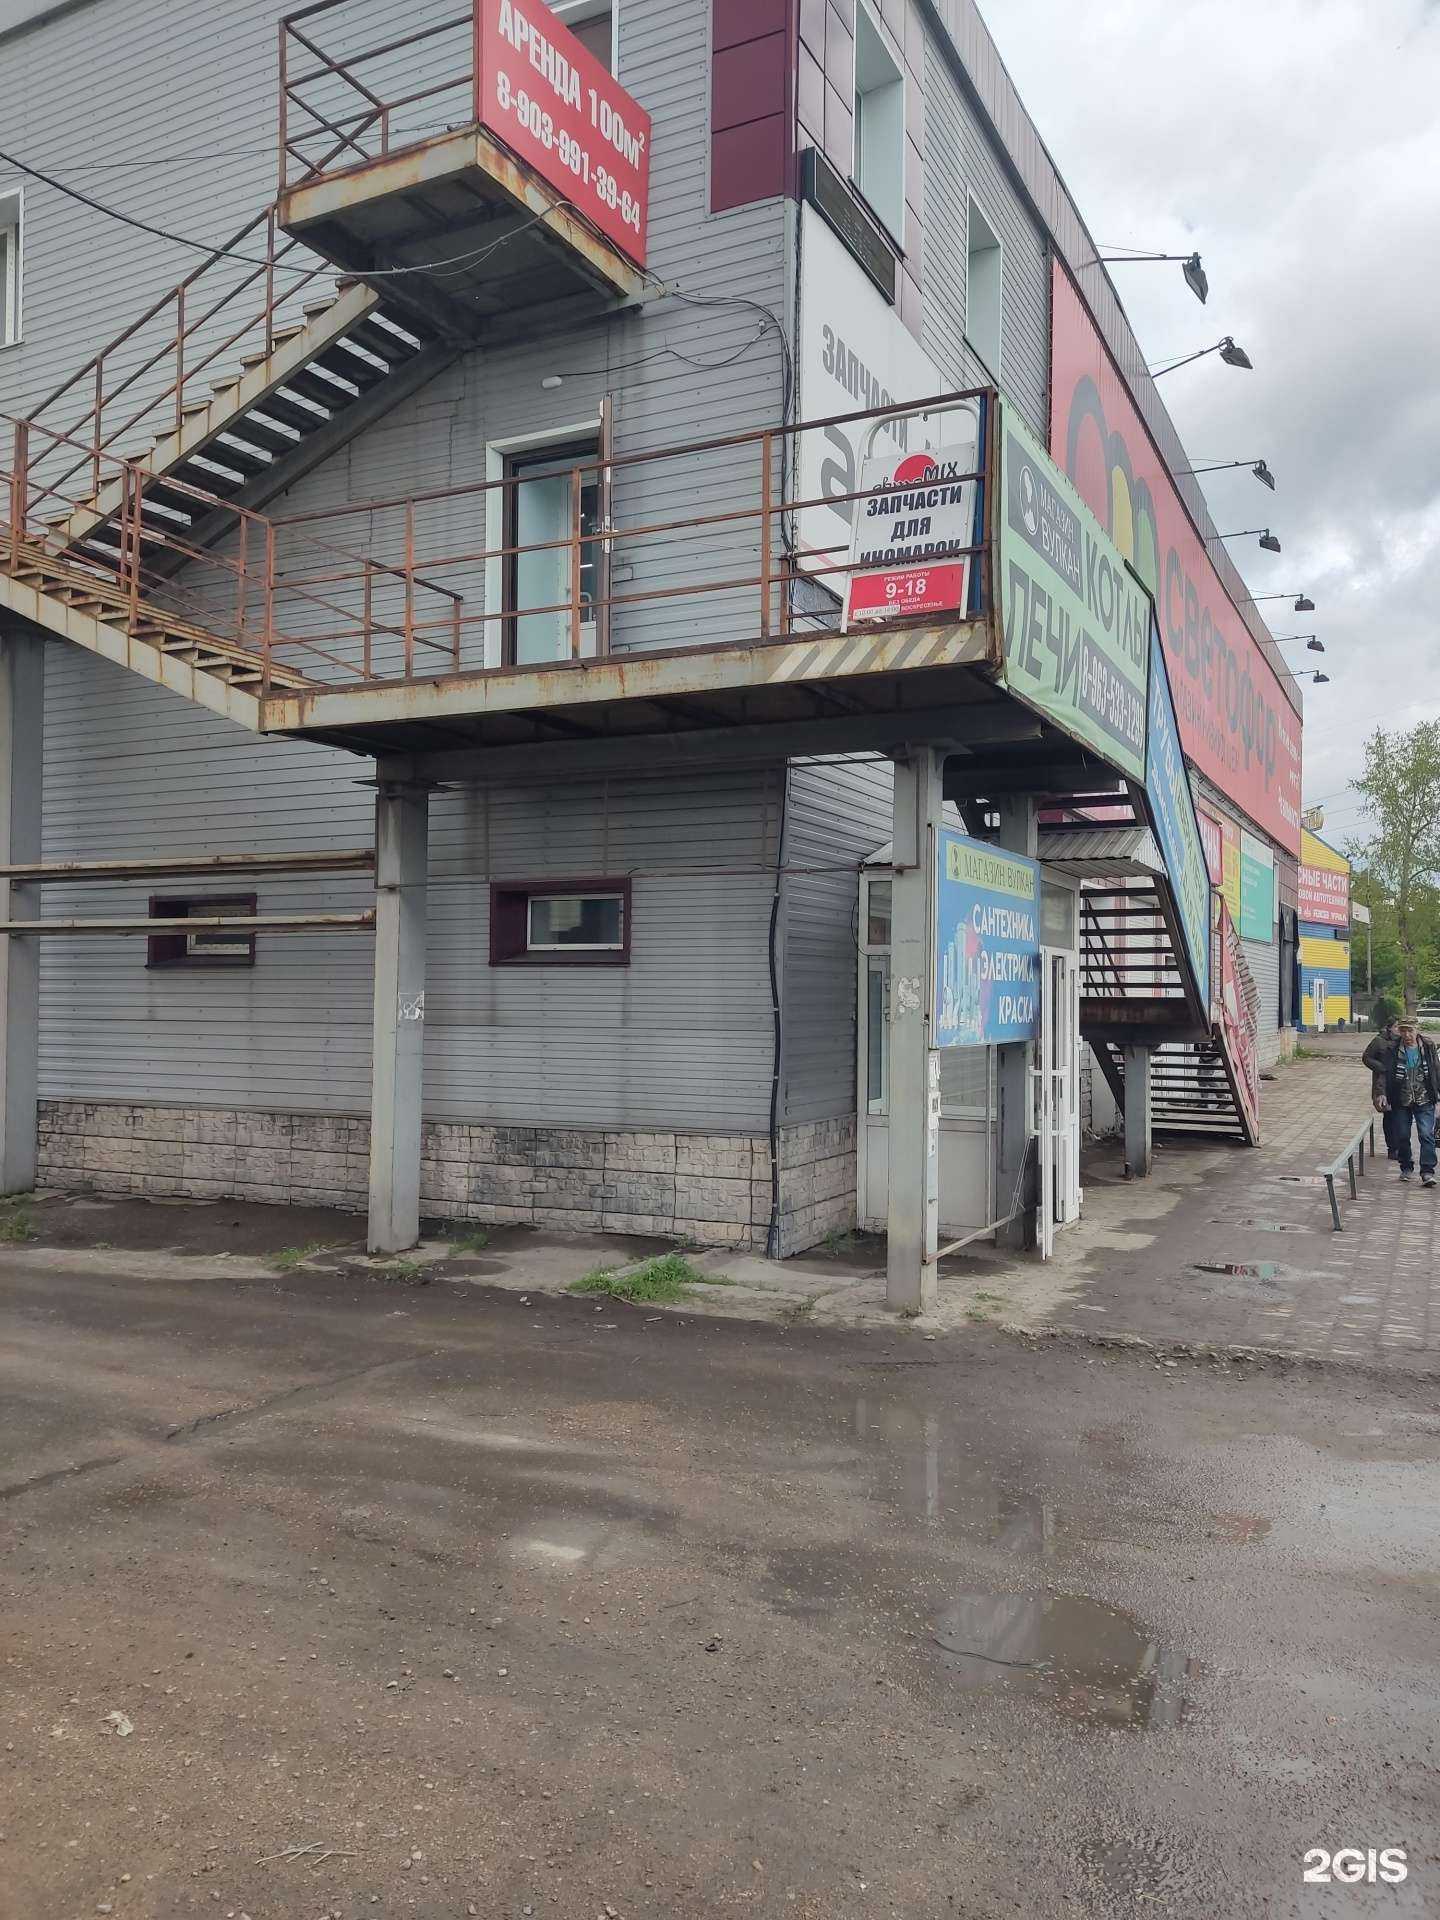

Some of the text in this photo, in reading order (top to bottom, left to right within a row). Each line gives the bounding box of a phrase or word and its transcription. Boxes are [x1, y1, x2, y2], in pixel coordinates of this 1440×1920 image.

[499, 0, 581, 112] АРЕНДА
[496, 71, 641, 234] 8-903-991-39-64
[867, 485, 962, 516] ЗАПЧАСТИ
[1040, 484, 1074, 543] МАГАЗИН
[891, 516, 931, 542] ДЛЯ
[1042, 516, 1081, 588] ВУЛКАН
[885, 578, 926, 598] 9-18
[1086, 530, 1146, 676] КОТЛЫ
[1005, 558, 1081, 708] ПЕЧИ
[964, 854, 1005, 888] МАГАЗИН
[1323, 872, 1348, 894] ЧАСТИ
[973, 904, 1034, 942] САНТЕХНИКА
[981, 951, 1034, 983] ЭЛЕКТРИКА
[999, 996, 1034, 1025] КРАСКА
